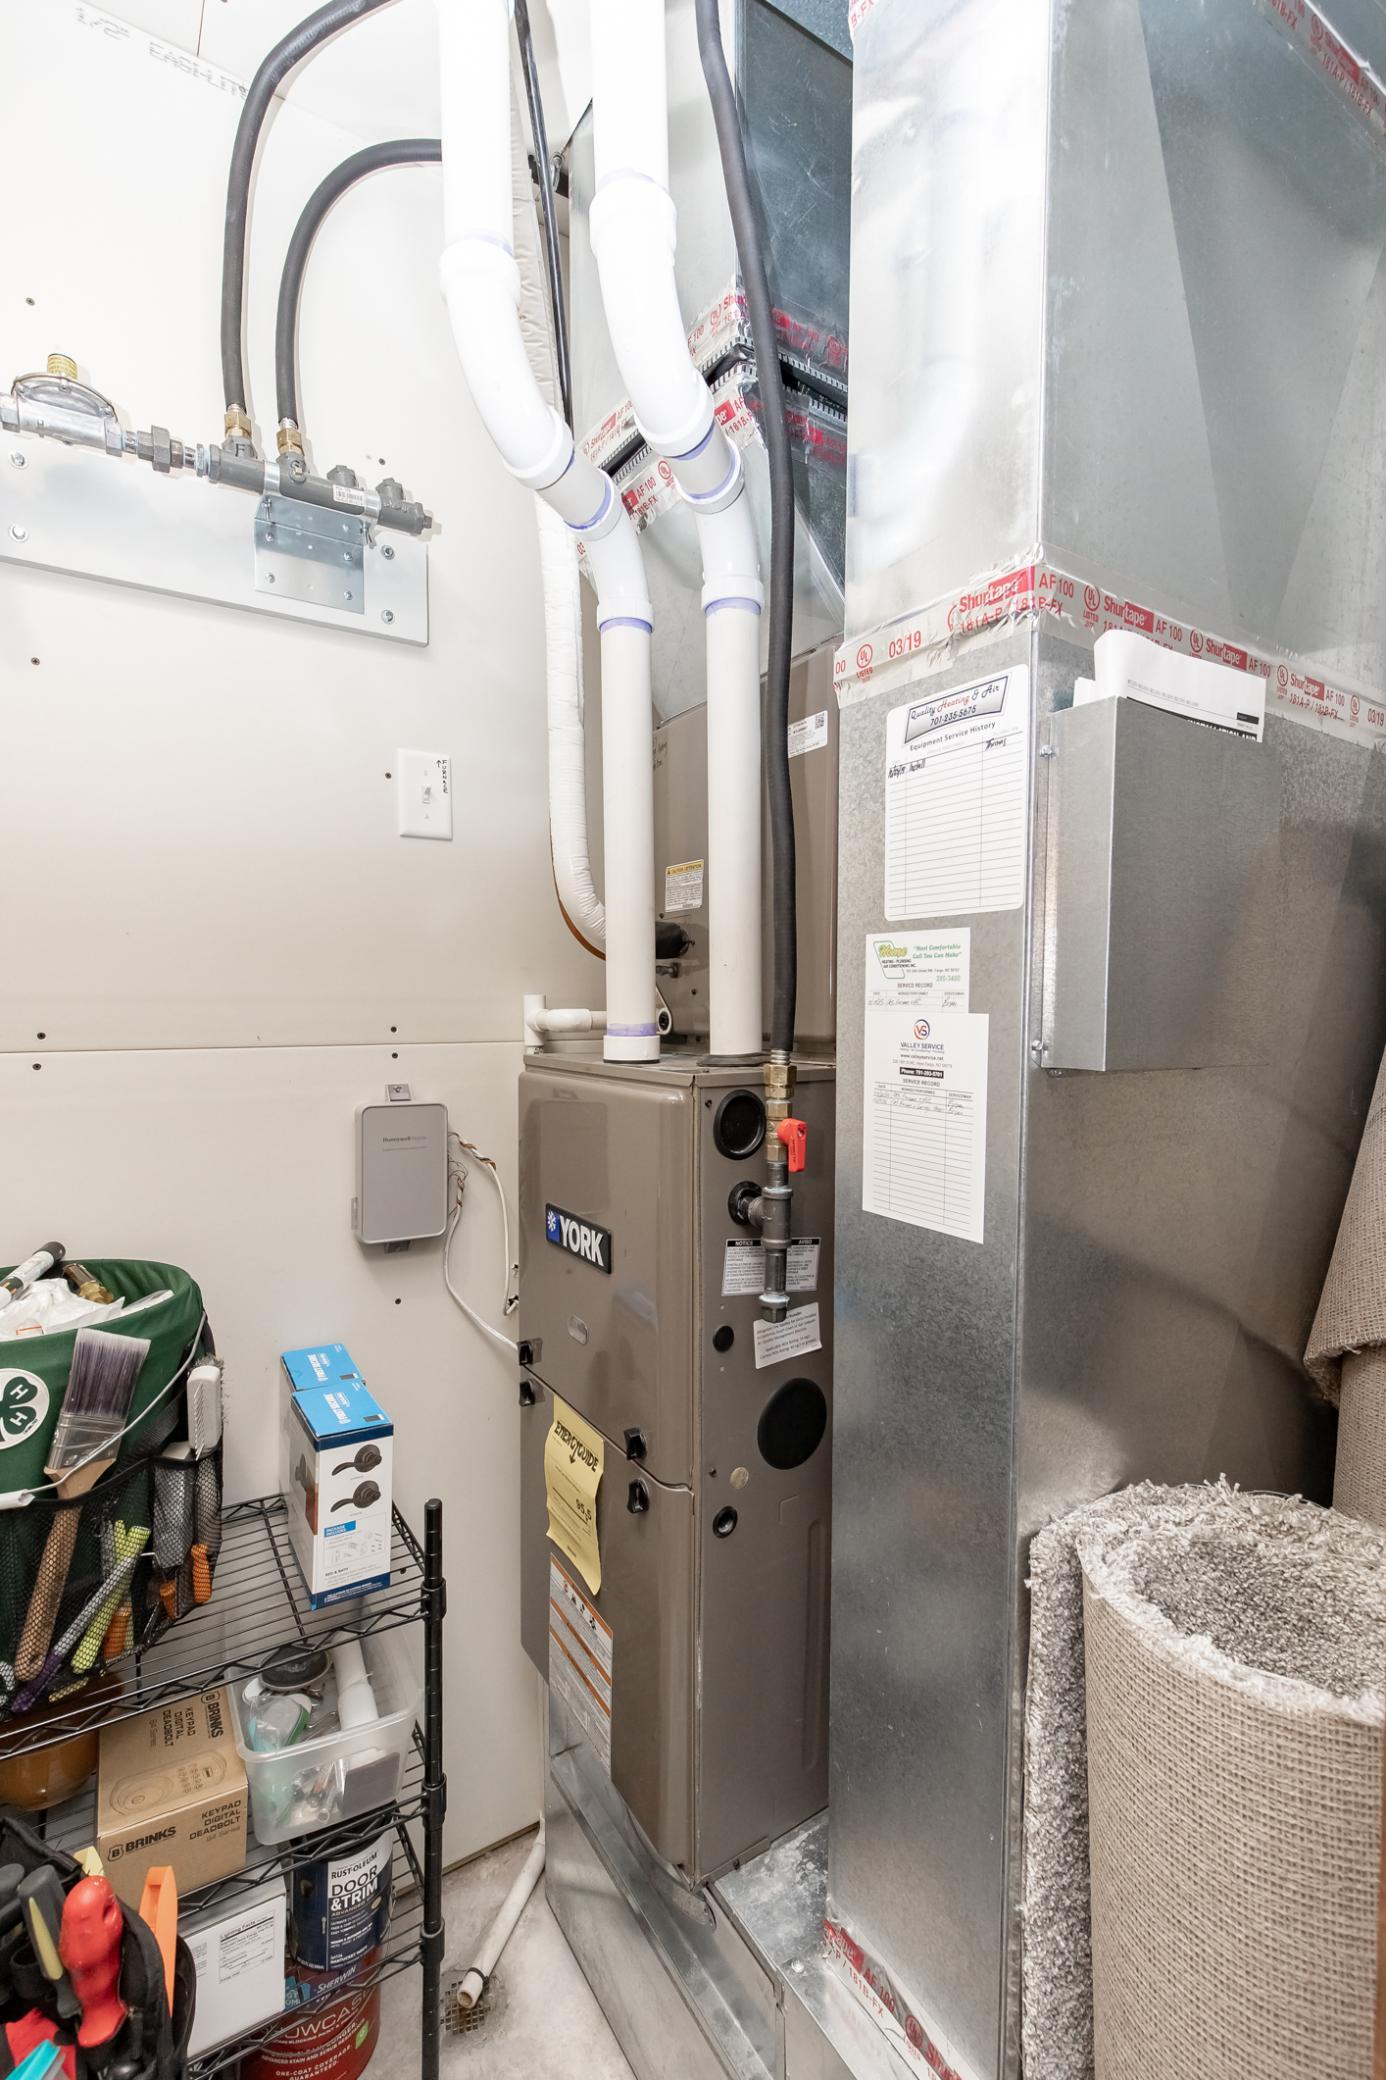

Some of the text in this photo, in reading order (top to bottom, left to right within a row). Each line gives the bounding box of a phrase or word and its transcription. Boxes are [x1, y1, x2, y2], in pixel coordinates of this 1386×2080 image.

[636, 484, 644, 498] AF
[645, 476, 657, 491] 100
[1039, 573, 1057, 589] AF
[1058, 579, 1074, 598] 100
[1103, 596, 1145, 626] Shurtape
[1156, 620, 1167, 635] AF
[1169, 625, 1183, 642] 100
[888, 630, 922, 658] 03/19
[1206, 638, 1241, 665] Shurtape
[1249, 658, 1258, 670] AF
[1260, 662, 1271, 678] 100
[910, 705, 936, 720] Quality
[937, 695, 970, 713] Heating
[981, 685, 999, 699] Air
[1326, 689, 1334, 701] AF
[1335, 693, 1345, 707] 100
[1367, 708, 1385, 727] 03/19
[910, 721, 996, 752] Equipment Service History
[900, 1041, 945, 1051] VALLEY SERVICE
[902, 1078, 940, 1087] SERVICE RECORD
[560, 1215, 604, 1267] YORK
[10, 1384, 29, 1400] H
[9, 1411, 28, 1427] H
[554, 1421, 600, 1473] ENERGYGUIDE
[162, 1709, 174, 1747] DEADBOLT
[174, 1711, 184, 1740] DIGITAL
[185, 1707, 196, 1737] KEYPAD
[208, 1702, 224, 1738] BRINKS
[201, 1800, 242, 1820] KEYPAD
[204, 1809, 241, 1826] DIGITAL
[125, 1826, 177, 1853] BRINKS
[189, 1816, 240, 1840] DEADBOLT
[330, 1876, 378, 1912] &TRIM
[332, 1864, 378, 1897] DOOR
[241, 1920, 256, 1929] Facts
[317, 1965, 357, 1994] SHERWIN
[306, 2053, 319, 2061] AND
[275, 2067, 312, 2076] ONE-COAT
